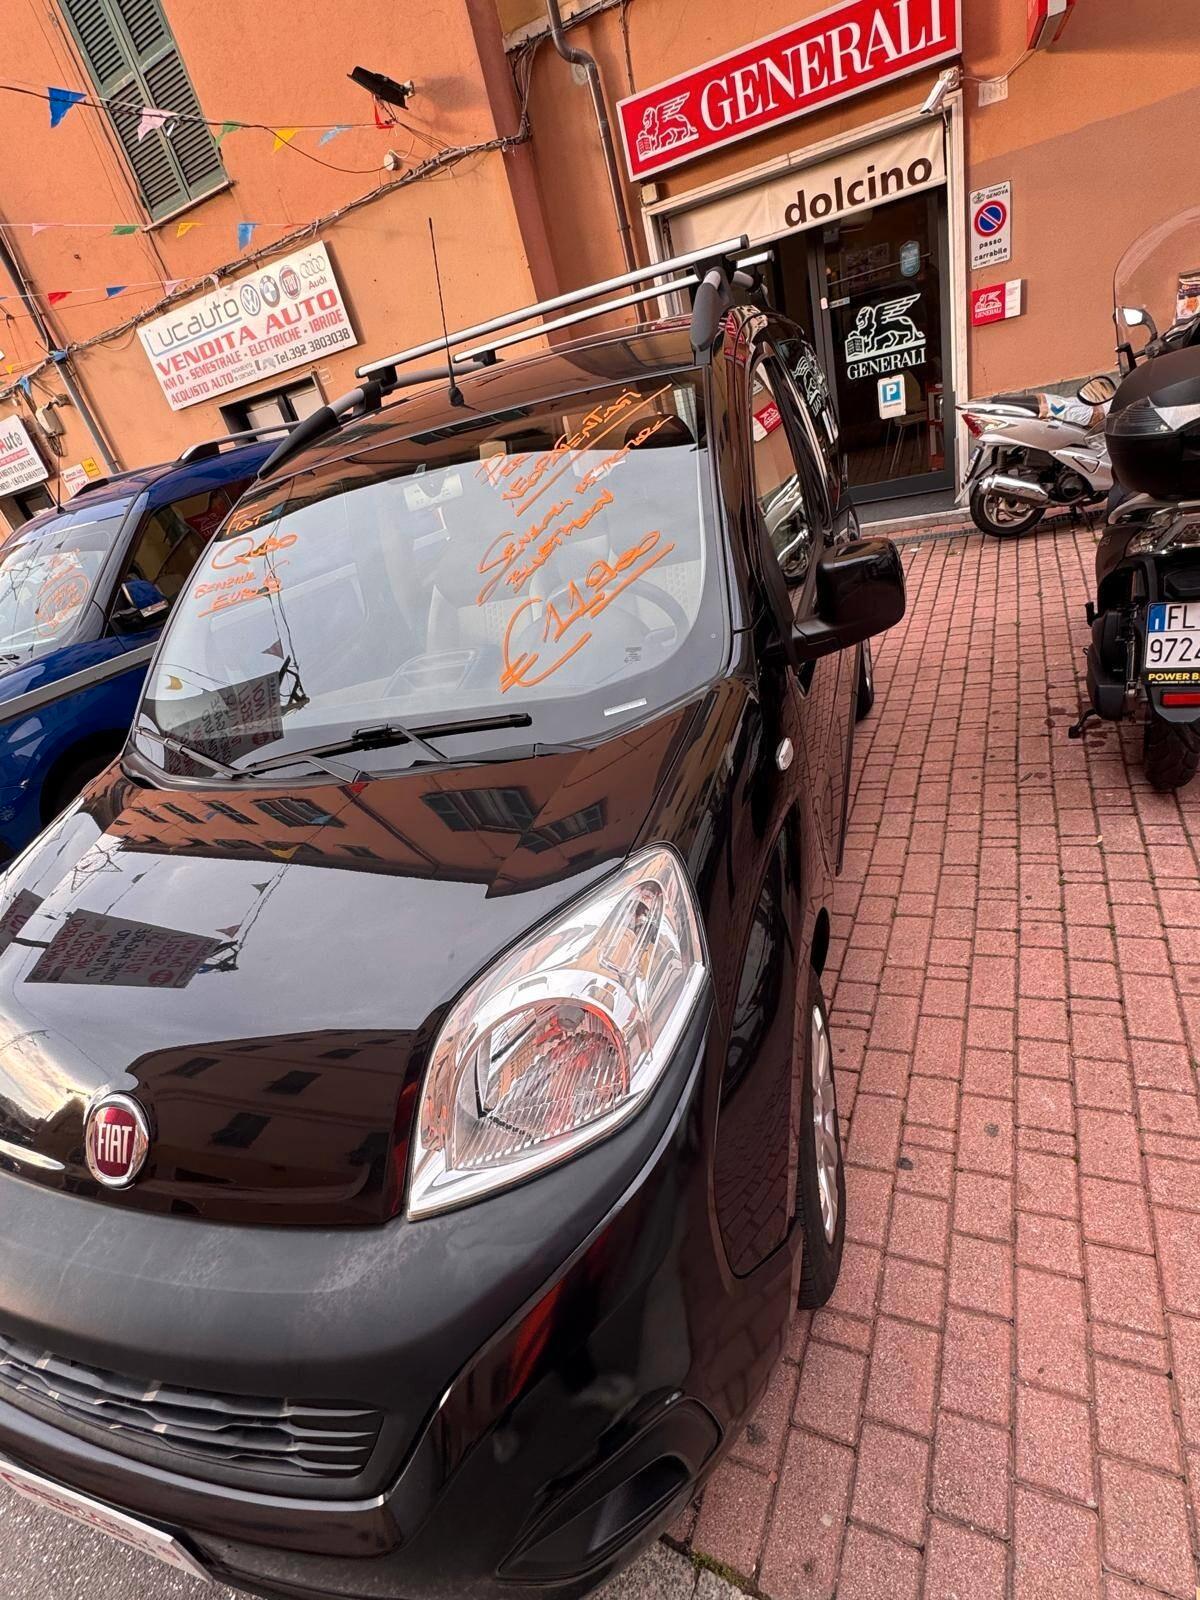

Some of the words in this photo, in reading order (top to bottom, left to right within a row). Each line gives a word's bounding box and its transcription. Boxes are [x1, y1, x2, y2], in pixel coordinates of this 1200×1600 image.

[700, 0, 947, 132] GENERALI
[784, 157, 933, 228] dolcino
[986, 188, 1009, 200] GENOVA
[974, 247, 1008, 262] carrabile
[979, 238, 1003, 250] passo
[308, 277, 327, 290] Audi
[156, 325, 258, 376] VENDITA
[266, 289, 338, 335] AUTO
[189, 351, 243, 380] SEMESTRALE
[248, 327, 302, 357] ELETTRICHE
[309, 309, 344, 333] IBRIDE
[308, 327, 351, 353] 3803038
[846, 347, 927, 380] GENERALI
[171, 382, 210, 405] ACQUISTO
[211, 372, 235, 391] AUTO
[1167, 605, 1196, 630] FL
[1148, 672, 1190, 681] POWER
[97, 1121, 133, 1165] FIAT
